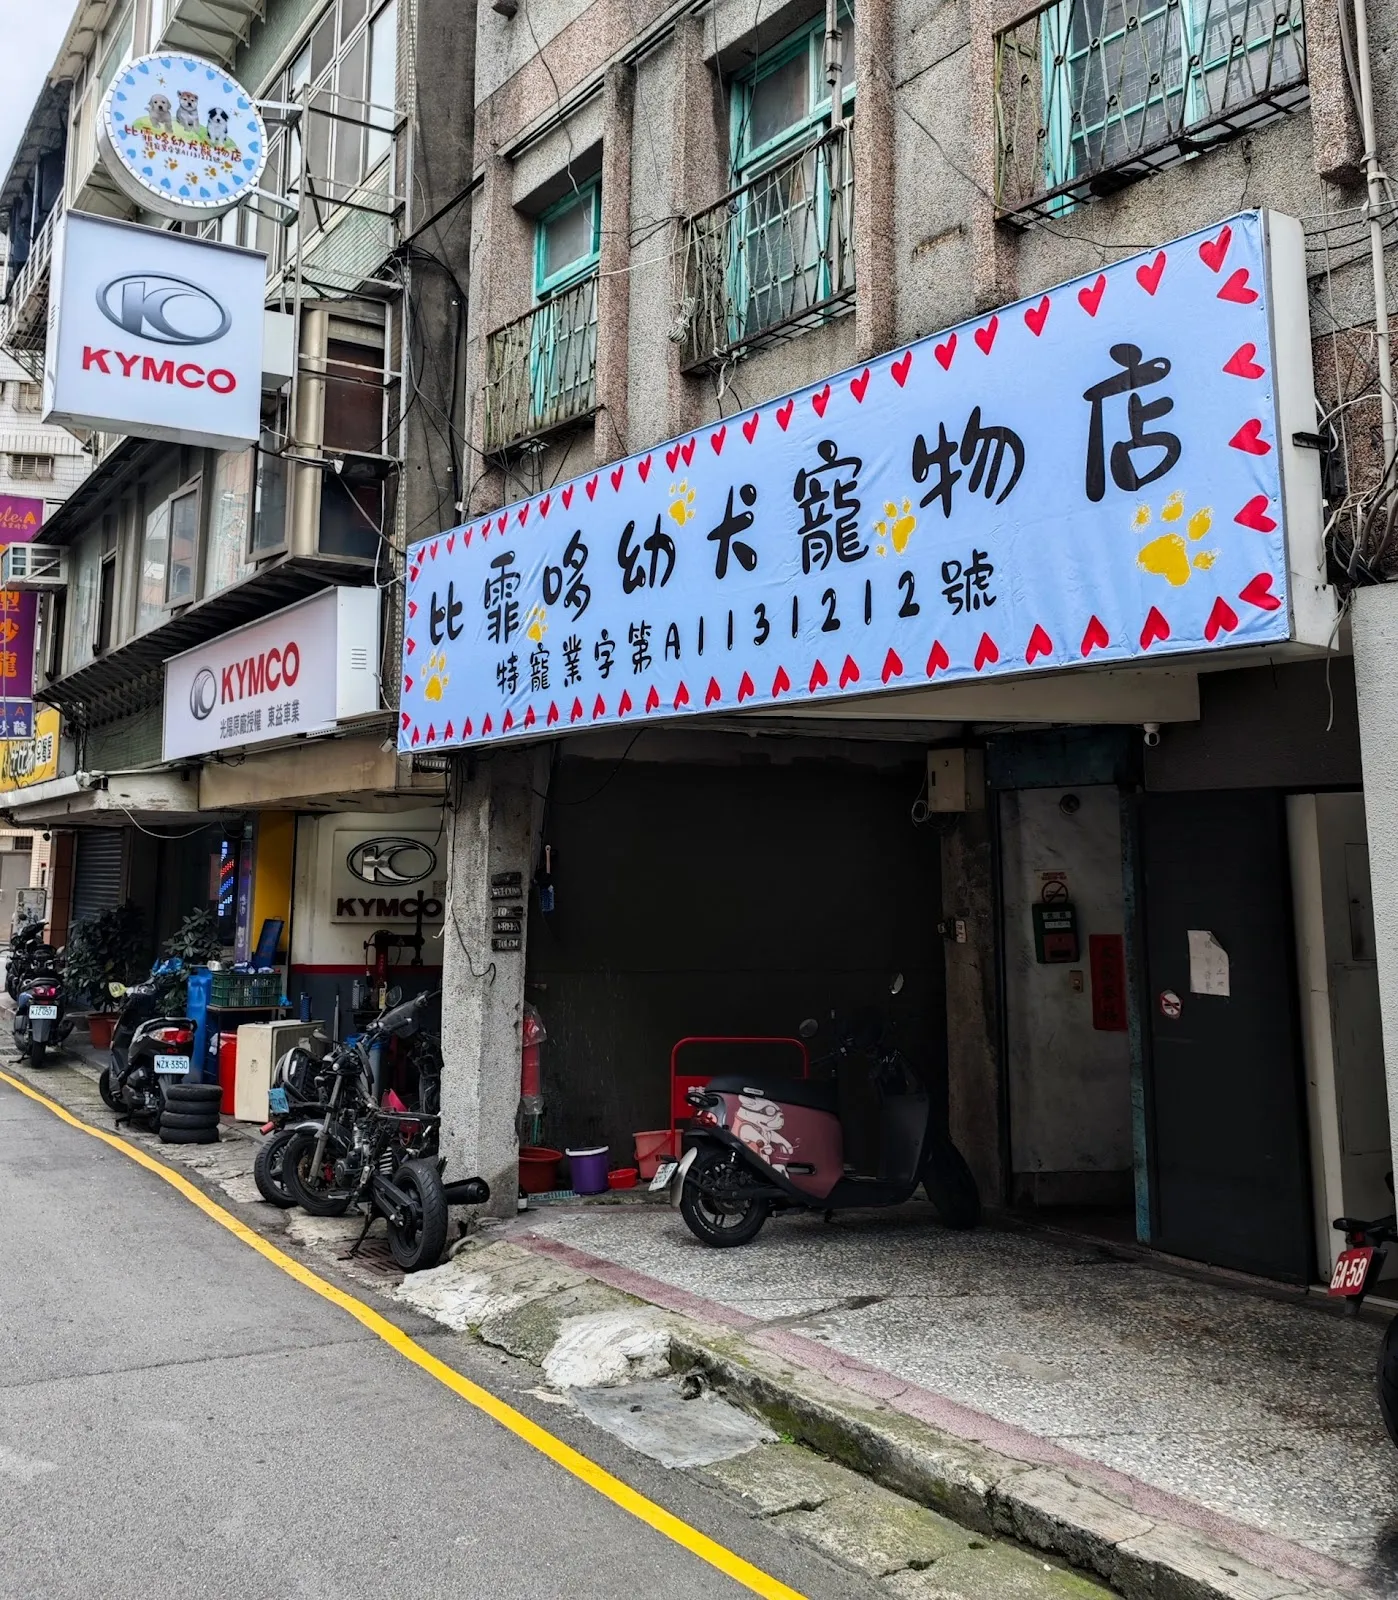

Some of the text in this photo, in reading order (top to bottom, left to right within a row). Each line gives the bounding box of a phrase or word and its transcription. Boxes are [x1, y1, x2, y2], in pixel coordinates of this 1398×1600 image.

[82, 345, 237, 394] KYMCO
[428, 343, 1184, 646] 比霏哆幼犬寵物店
[221, 641, 300, 705] KYMCO
[267, 699, 300, 728] 東益車業
[156, 1060, 188, 1069] NZX-3350
[1330, 1257, 1368, 1289] GA-58
